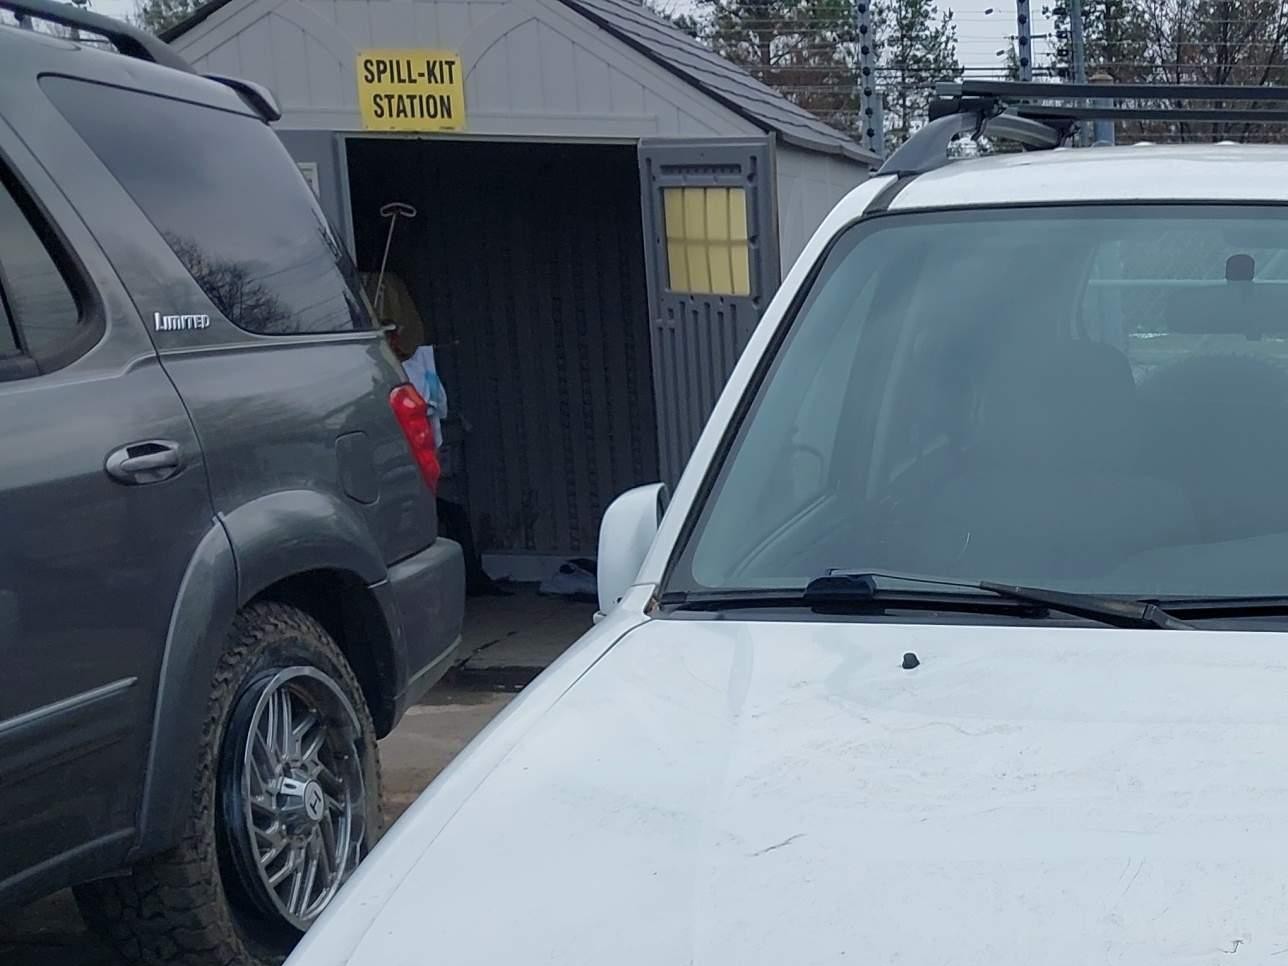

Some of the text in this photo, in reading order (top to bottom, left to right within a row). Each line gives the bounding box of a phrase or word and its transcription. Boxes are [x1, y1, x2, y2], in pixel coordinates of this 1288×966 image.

[363, 59, 456, 85] SPILL-KIT
[373, 94, 452, 119] STATION
[154, 312, 210, 331] LIMITED
